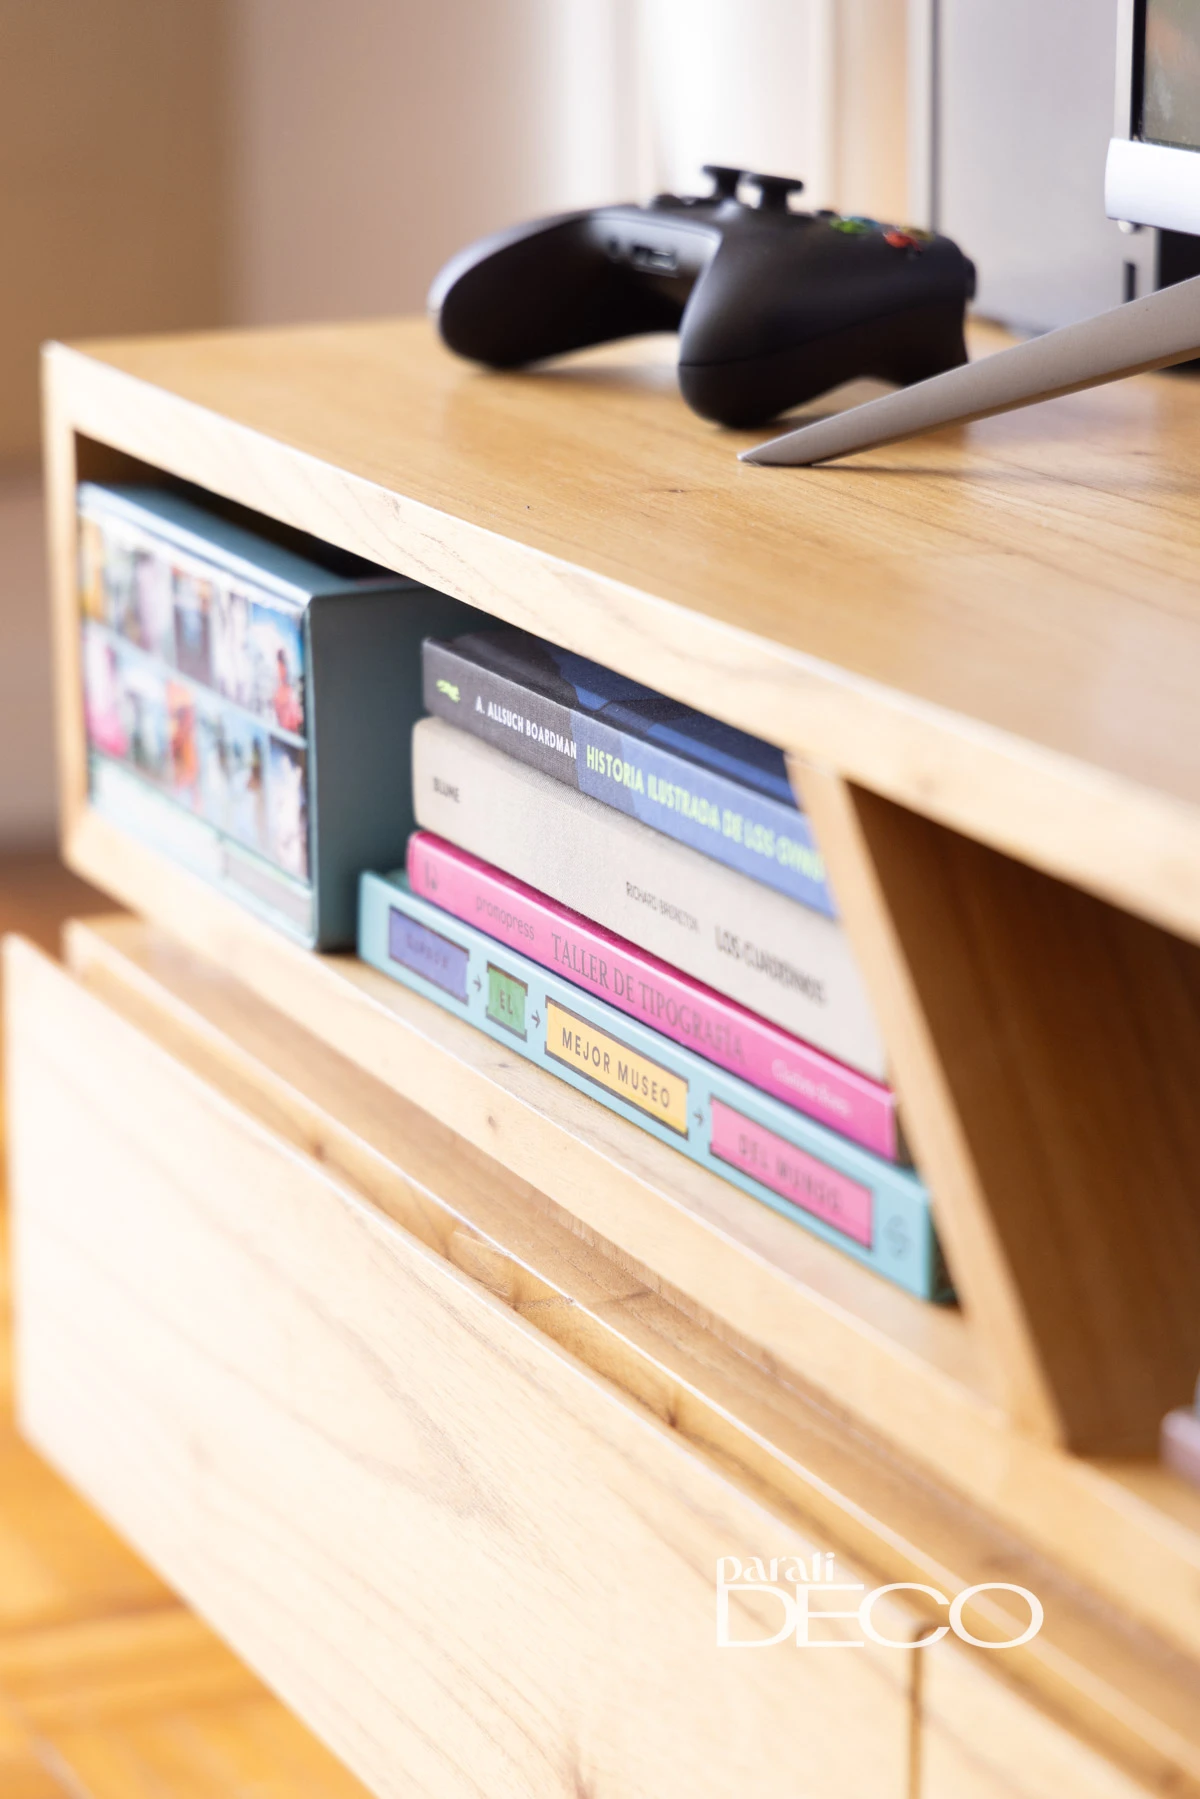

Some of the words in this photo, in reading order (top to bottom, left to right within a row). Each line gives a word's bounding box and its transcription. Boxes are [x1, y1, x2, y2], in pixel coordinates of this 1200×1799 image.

[475, 695, 485, 714] A.
[487, 701, 524, 734] ALLSUCH
[525, 719, 577, 760] BOARDMAN
[586, 743, 645, 795] HISTORIA
[647, 773, 721, 832] ILUSTRADA
[722, 808, 744, 844] DE
[476, 896, 535, 941] promopress
[551, 932, 610, 990] TALLER
[613, 967, 636, 1004] DE
[499, 988, 514, 1015] EL
[562, 1027, 611, 1075] MEJOR
[617, 1060, 671, 1109] MUSEO
